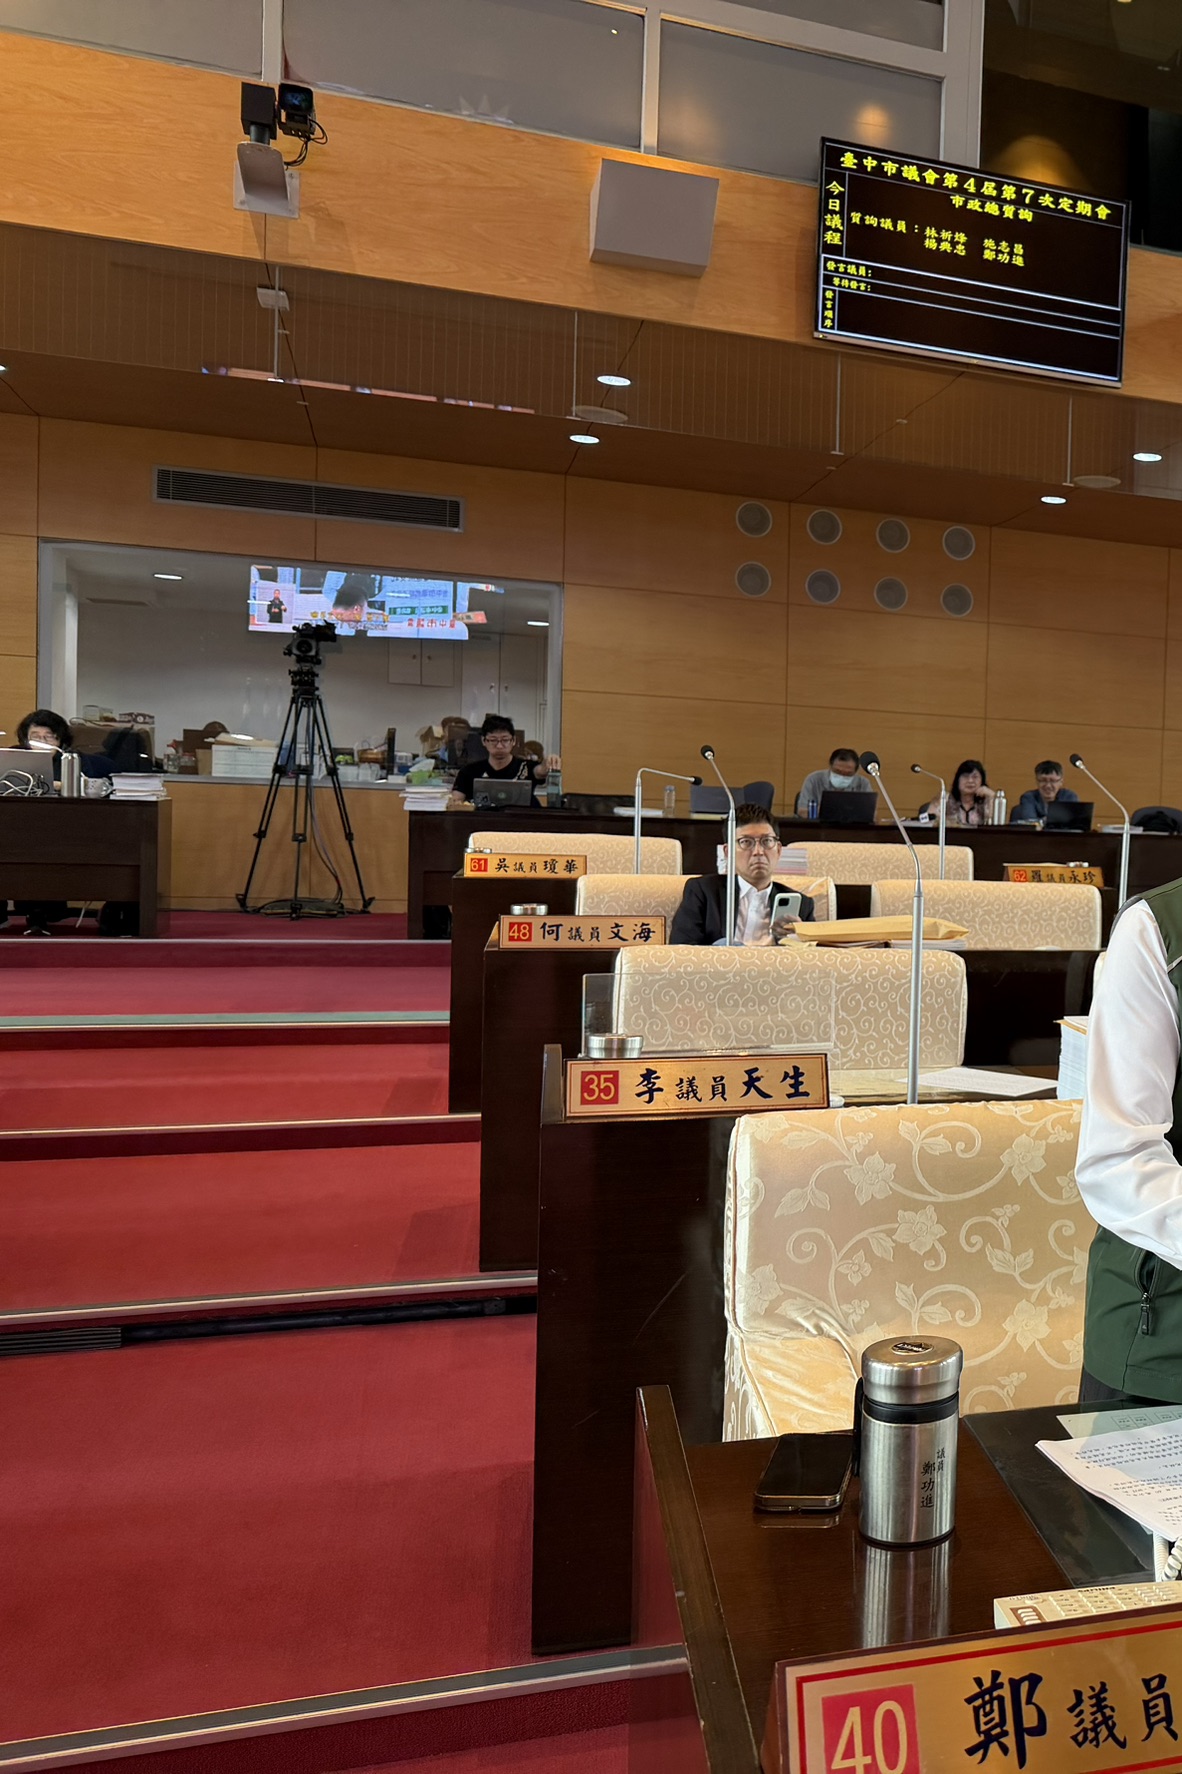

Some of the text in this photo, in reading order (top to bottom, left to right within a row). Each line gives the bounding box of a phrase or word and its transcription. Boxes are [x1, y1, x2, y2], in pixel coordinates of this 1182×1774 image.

[840, 152, 1111, 220] 臺中市議會第4屆第7次定期會
[823, 181, 845, 245] 今日議程
[950, 194, 1033, 222] 市政總質詢
[983, 249, 1025, 267] 鄭功進
[471, 858, 578, 874] 61 吳議員瓊華
[509, 922, 656, 942] 48 何議員文海
[583, 1065, 811, 1104] 35 李議員天生
[936, 1447, 945, 1473] 議員
[920, 1461, 936, 1509] 鄭功進
[831, 1700, 908, 1774] 40
